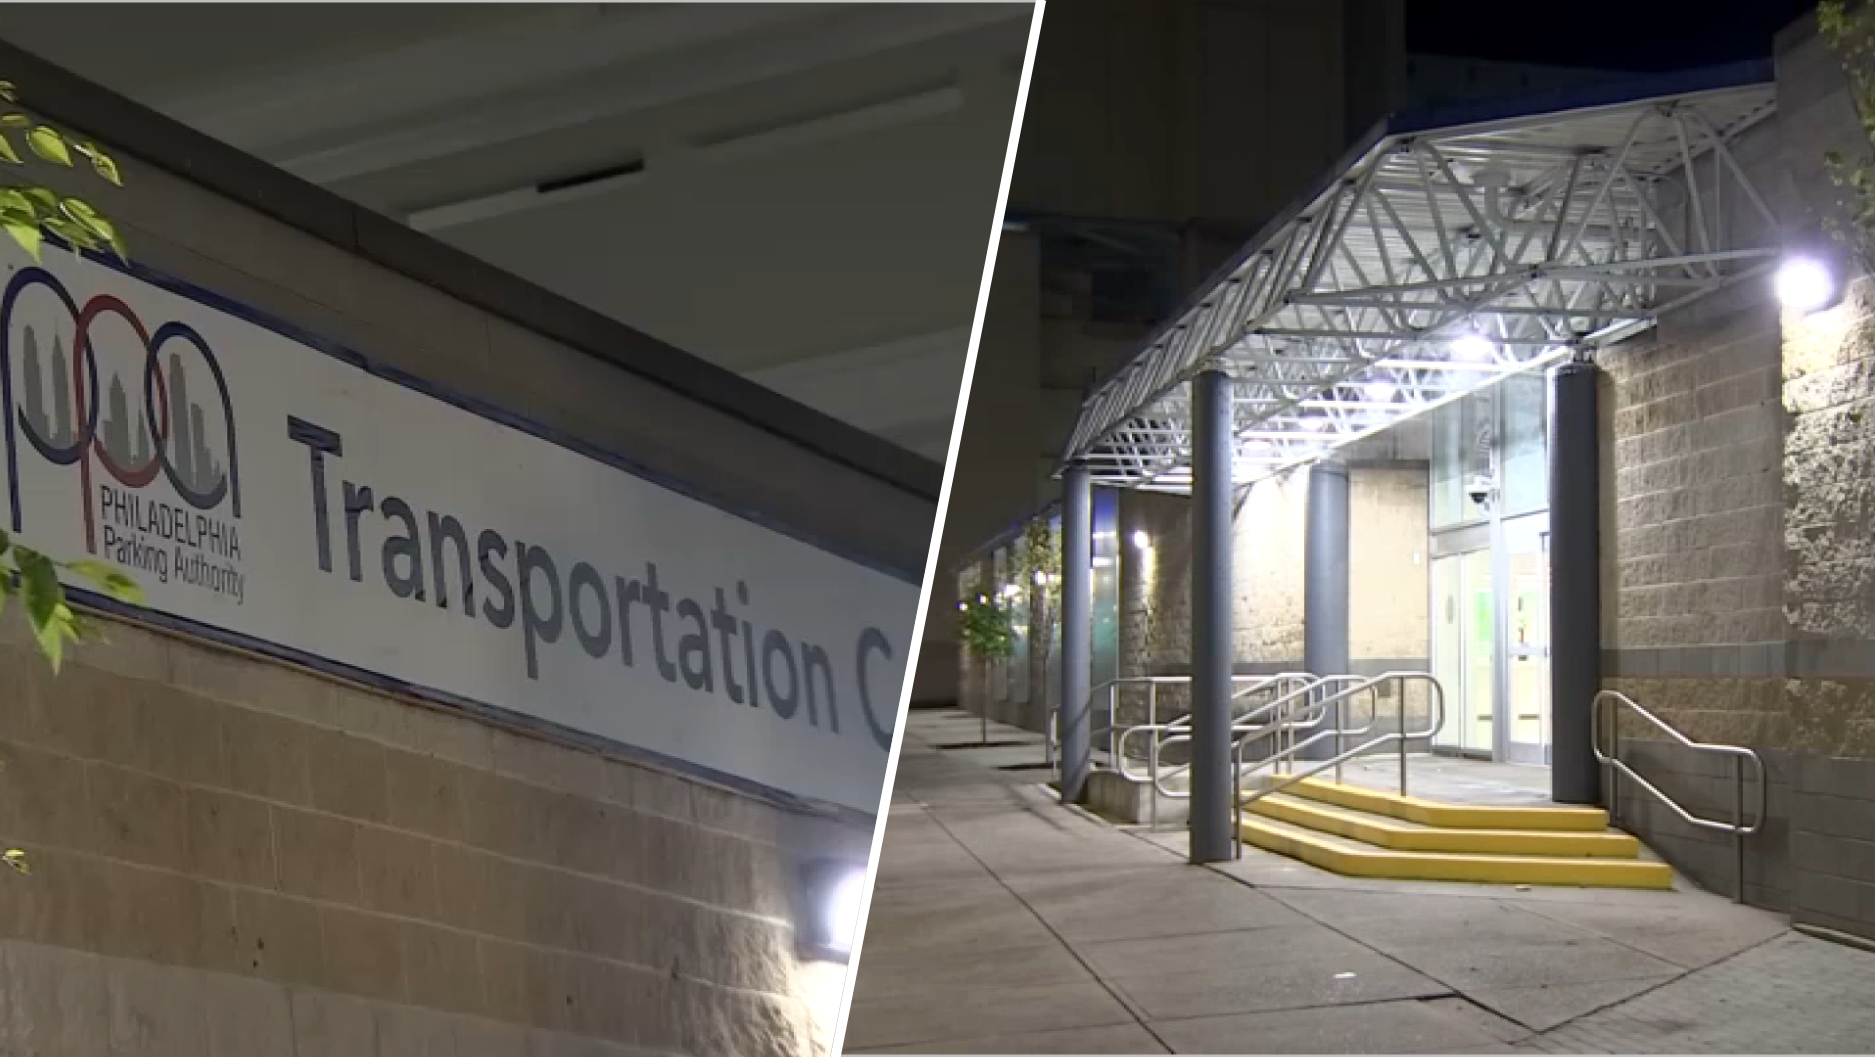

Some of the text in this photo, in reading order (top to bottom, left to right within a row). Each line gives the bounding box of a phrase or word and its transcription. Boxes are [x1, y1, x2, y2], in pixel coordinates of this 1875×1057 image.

[101, 484, 241, 560] PHILADELPHIA
[103, 524, 243, 605] Parking Authority
[287, 414, 838, 733] Transportation
